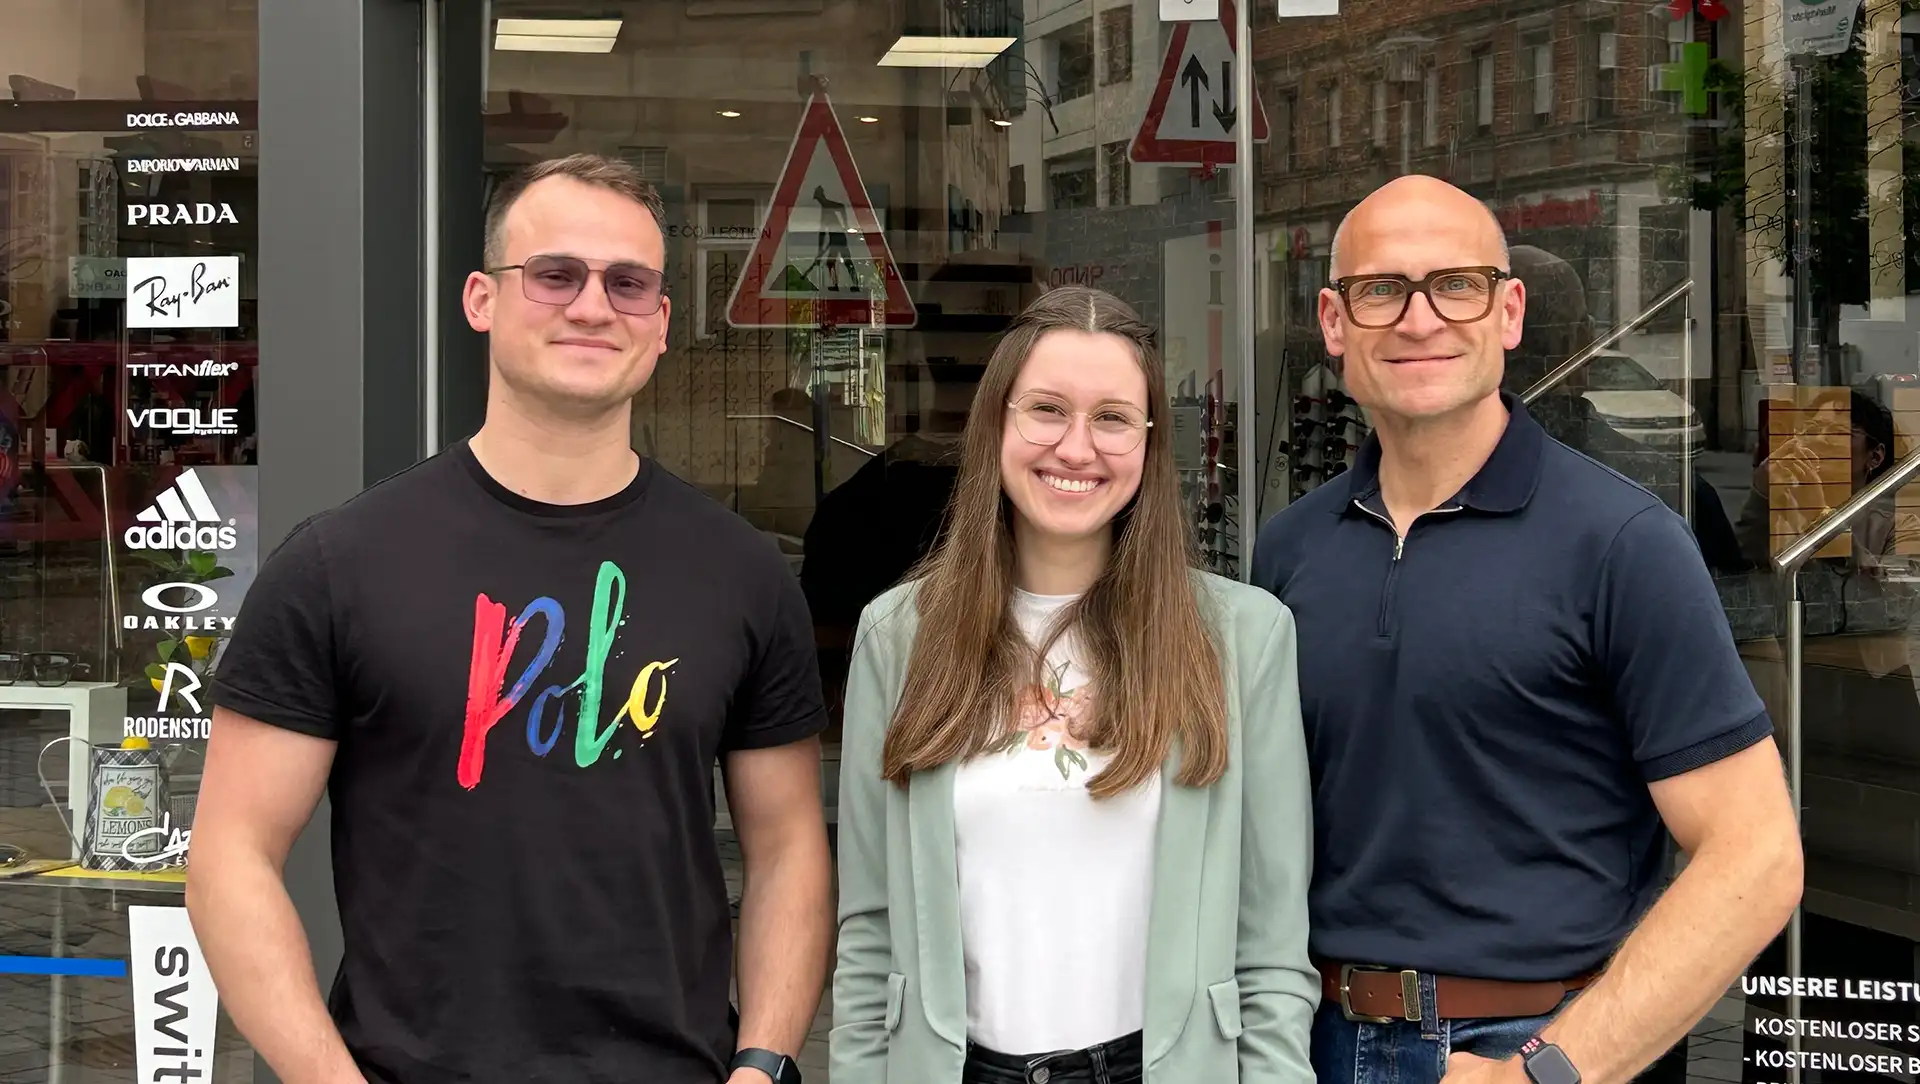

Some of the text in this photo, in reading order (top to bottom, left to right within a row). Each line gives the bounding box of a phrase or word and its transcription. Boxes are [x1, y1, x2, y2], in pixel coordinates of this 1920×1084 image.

[127, 203, 239, 225] PRADA
[127, 409, 238, 435] VOGUE
[124, 520, 236, 550] adidas
[124, 615, 236, 630] OAKLEY
[457, 560, 680, 790] Polo
[1741, 974, 1838, 998] UNSERE
[1755, 1017, 1903, 1042] KOSTENLOSER
[1756, 1049, 1903, 1074] KOSTENLOSER
